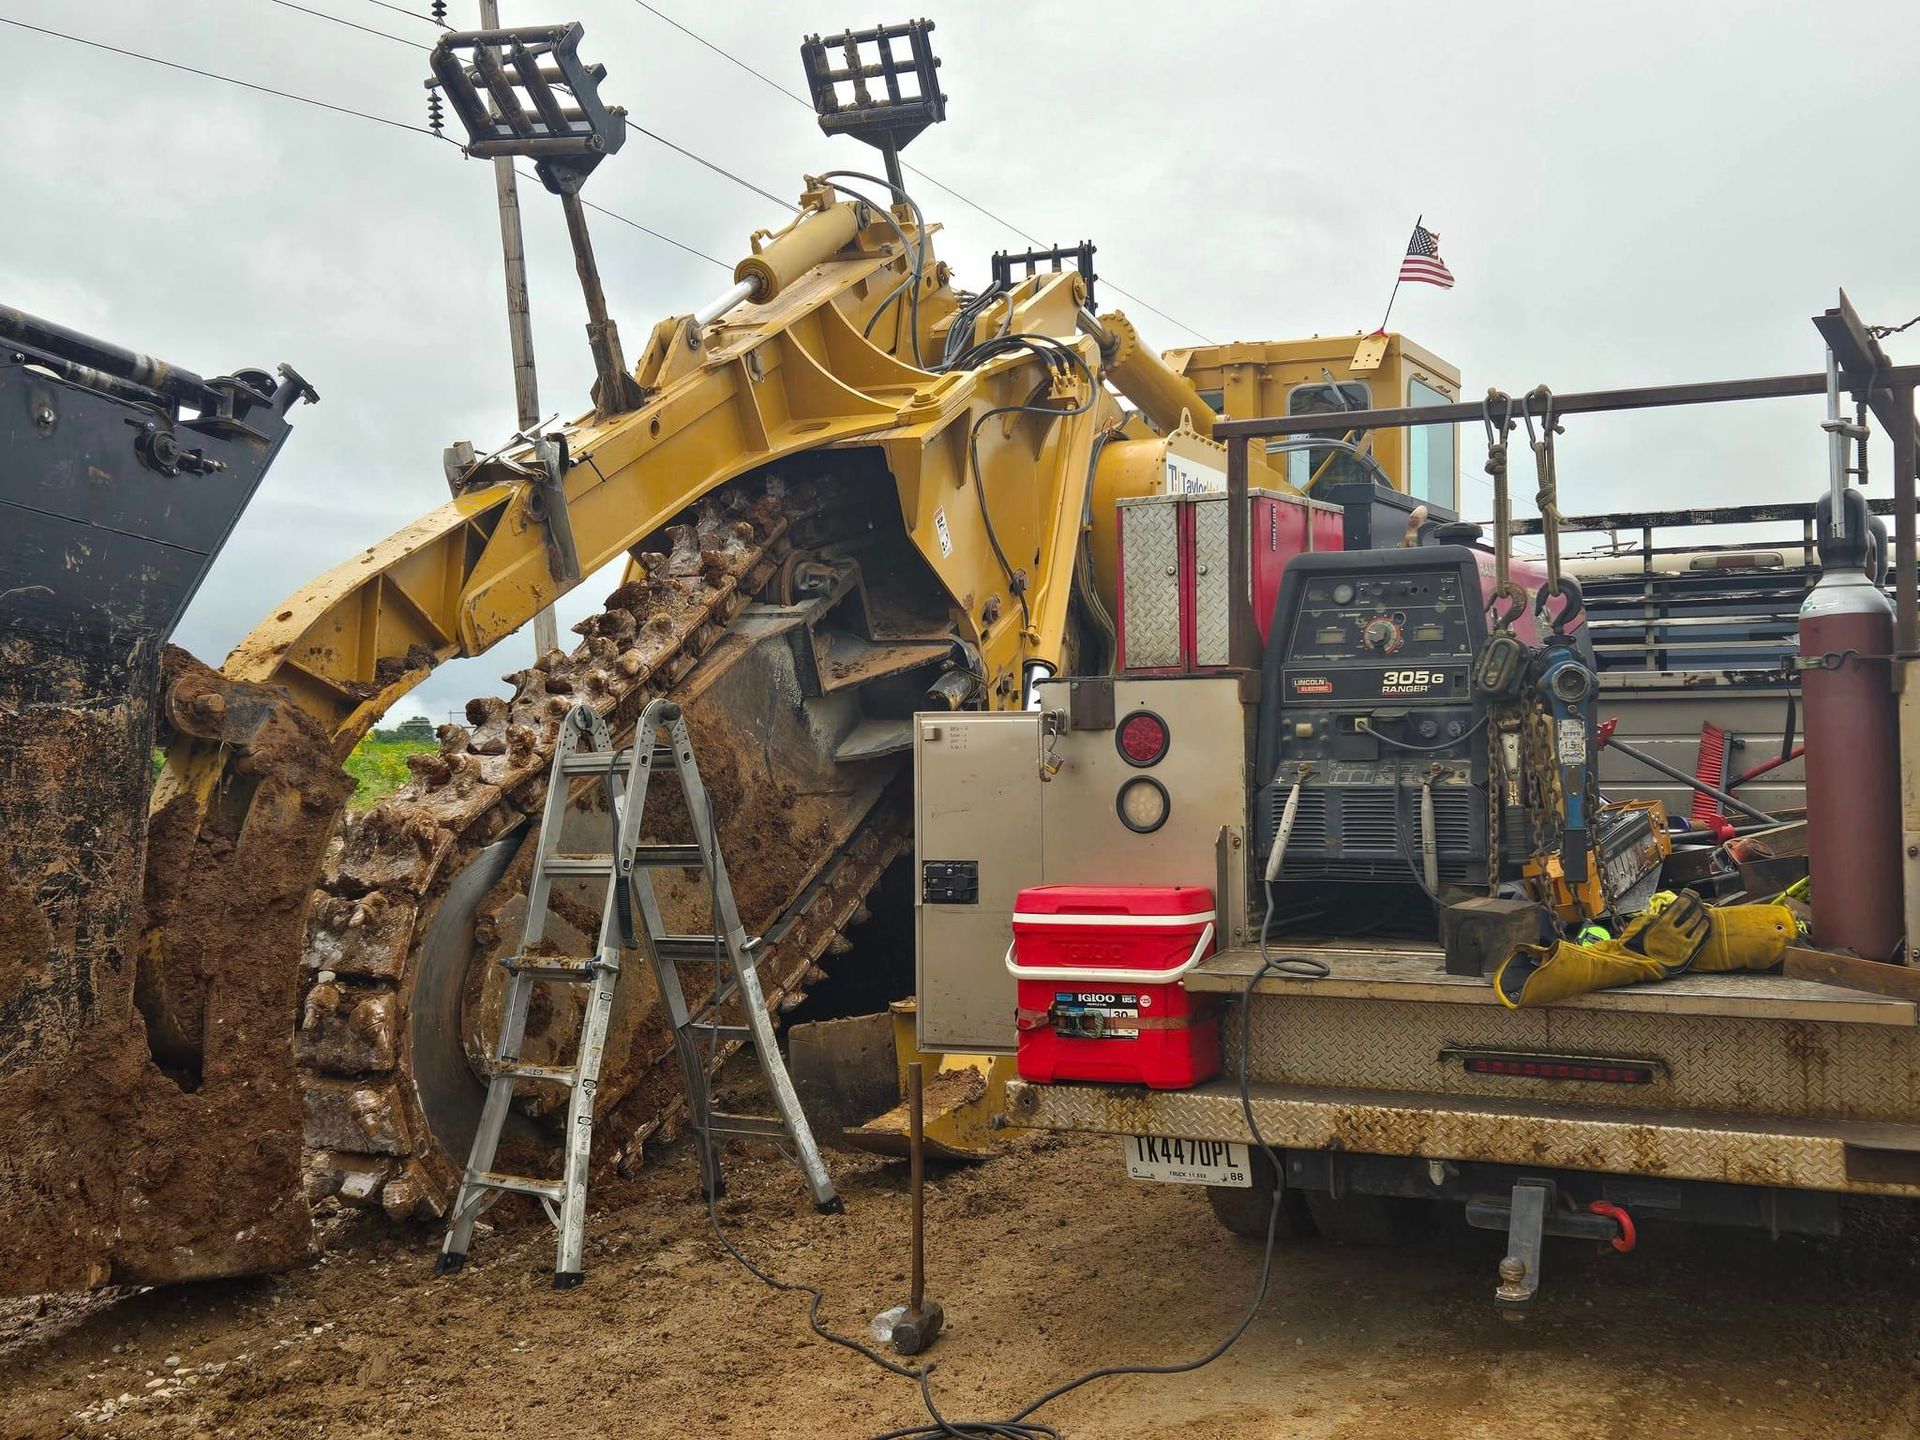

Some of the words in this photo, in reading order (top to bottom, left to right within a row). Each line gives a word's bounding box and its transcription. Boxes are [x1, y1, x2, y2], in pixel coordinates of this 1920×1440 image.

[1294, 679, 1325, 687] LINCOLN
[1382, 685, 1429, 693] RANGER
[1077, 993, 1116, 1004] IGLOO
